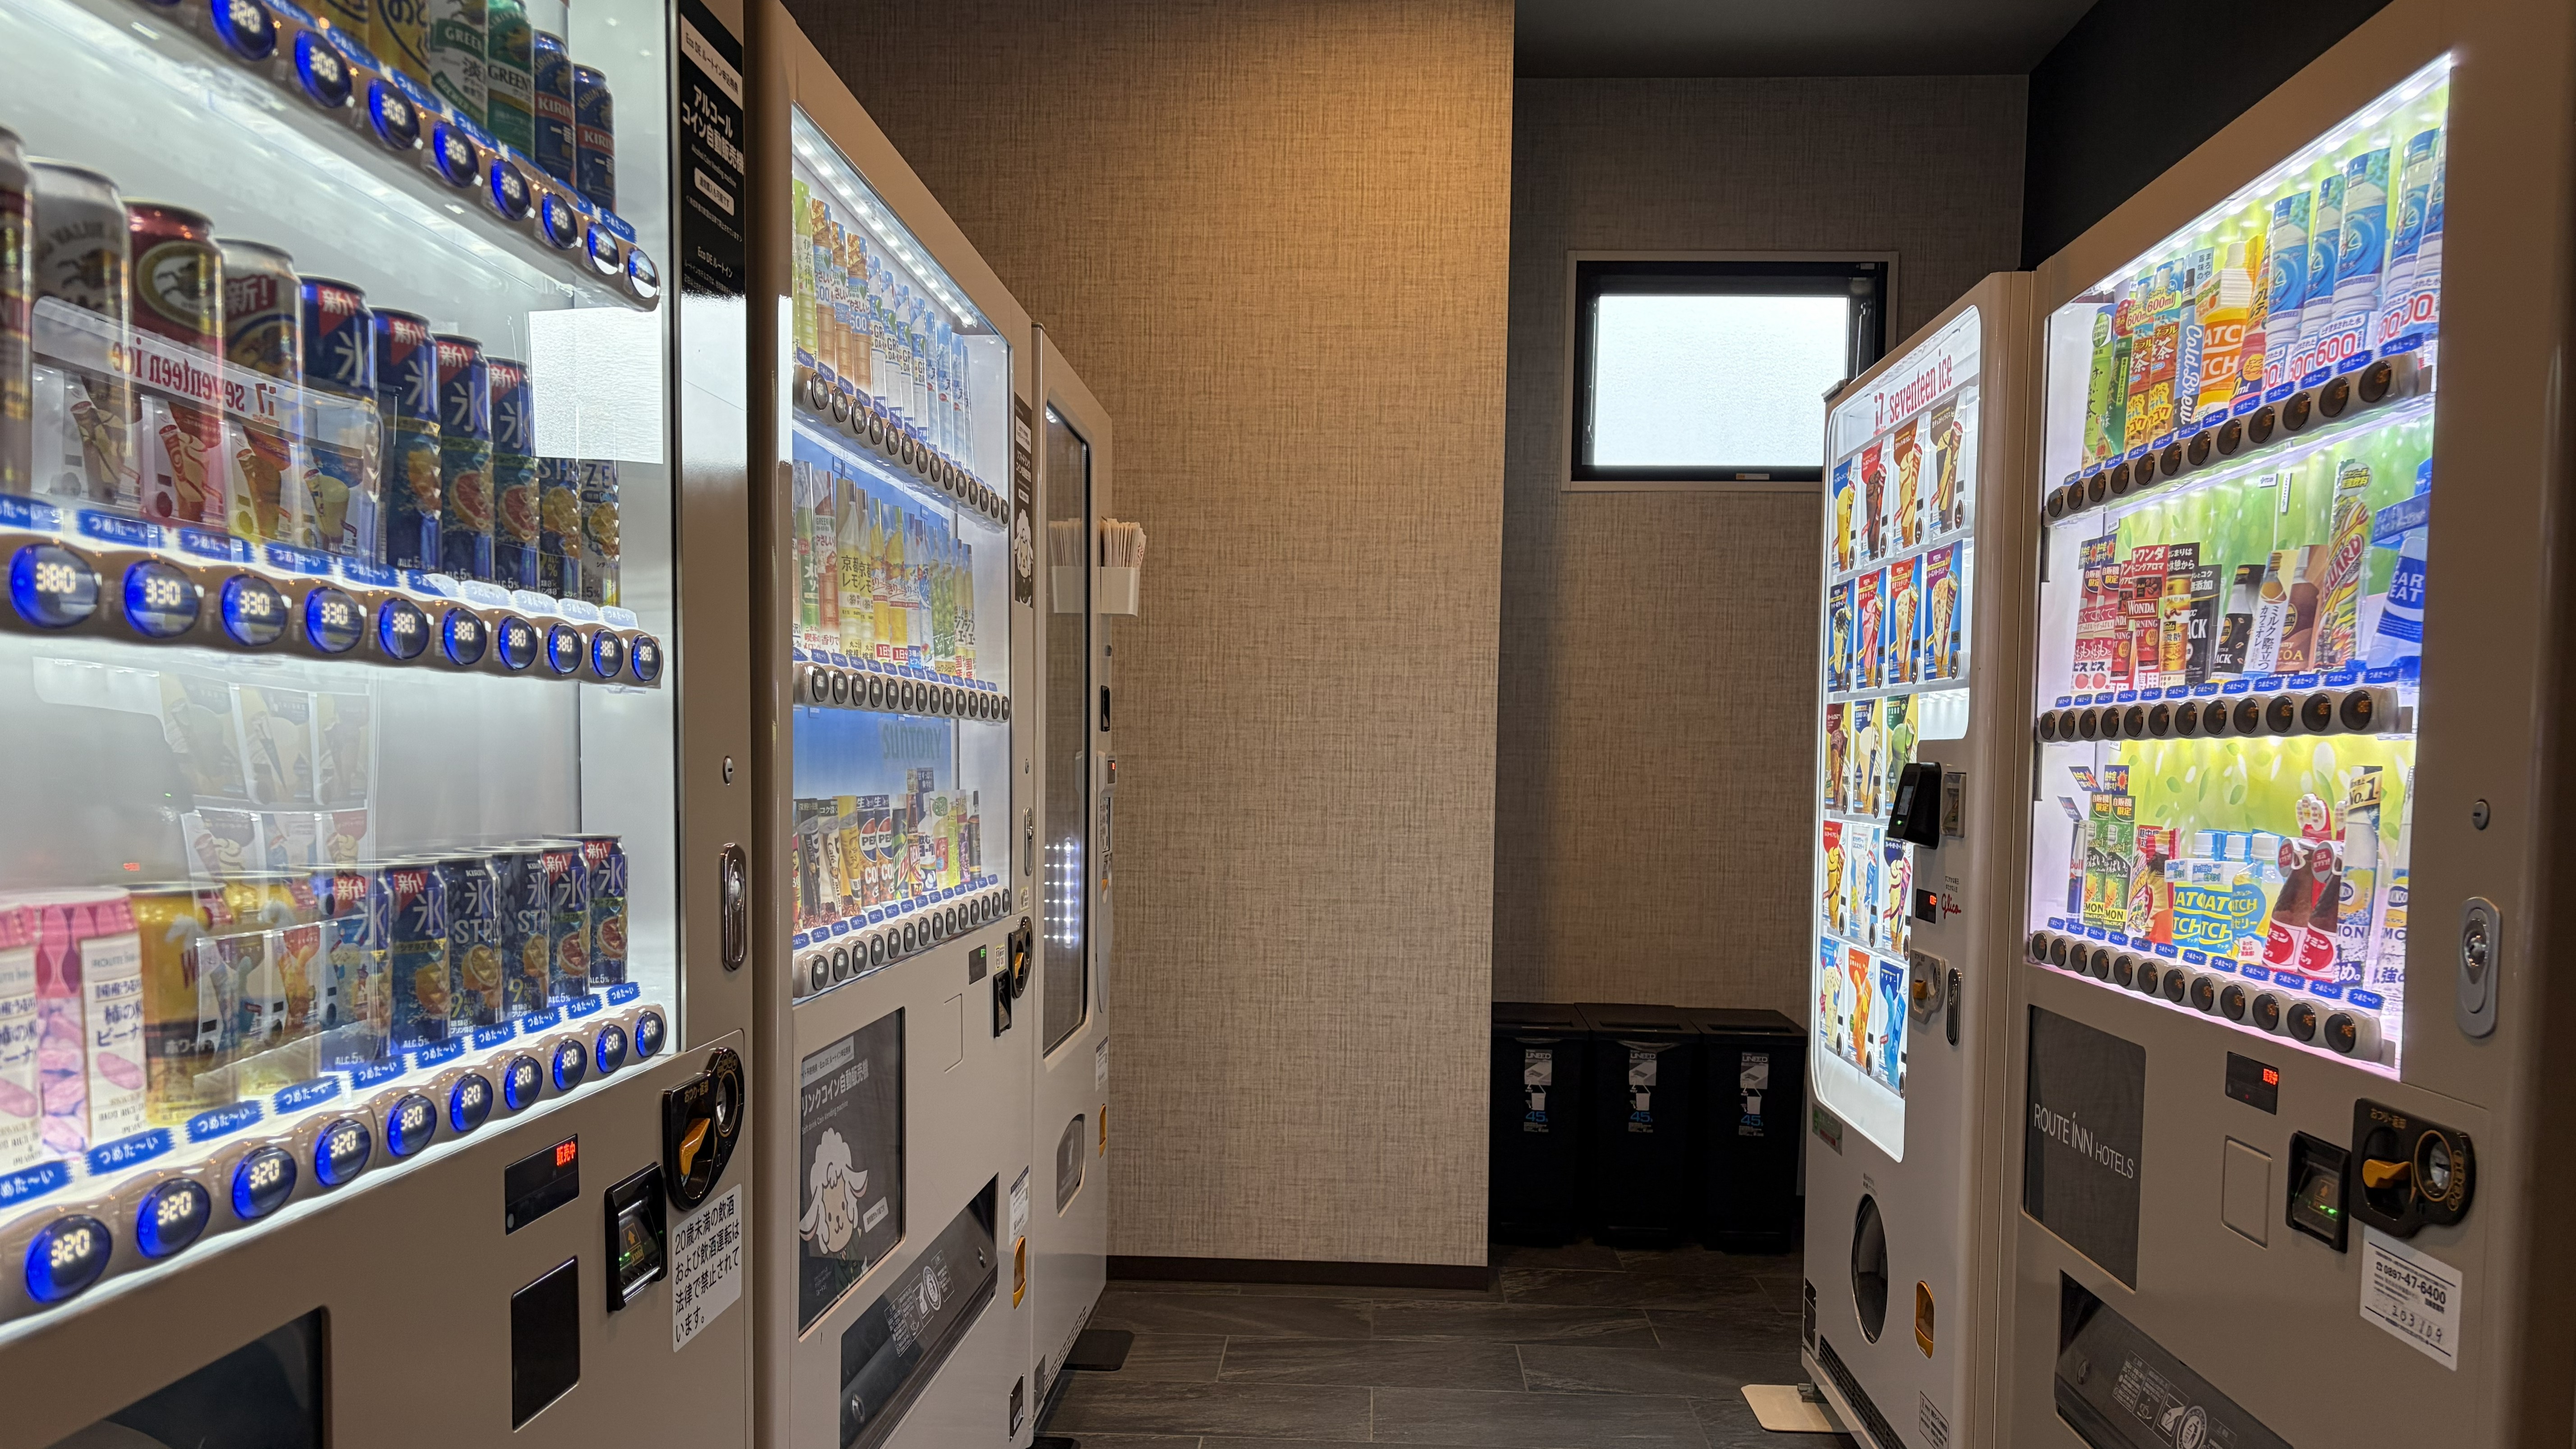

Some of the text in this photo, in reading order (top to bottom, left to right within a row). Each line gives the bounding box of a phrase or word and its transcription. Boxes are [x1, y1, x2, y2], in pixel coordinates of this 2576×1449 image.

[2147, 294, 2174, 313] 600ml
[2315, 333, 2356, 368] 600
[1890, 367, 1937, 424] seventeen
[1939, 348, 1952, 394] ice
[36, 563, 76, 593] 380
[146, 579, 180, 605] 330
[240, 592, 270, 615] 330
[321, 602, 348, 625] 330
[2127, 599, 2156, 616] WONDA
[393, 612, 415, 633] 380
[454, 622, 474, 640] 380
[509, 629, 526, 646] 380
[557, 636, 572, 652] 380
[600, 641, 614, 657] 380
[639, 646, 652, 661] 380
[2117, 807, 2132, 816] 限定
[587, 842, 608, 860] 新!
[1941, 893, 1962, 920] Glico
[644, 1020, 656, 1036] 320
[605, 1034, 618, 1051] 320
[562, 1049, 577, 1068] 320
[515, 1066, 532, 1087] 320
[461, 1085, 481, 1108] 320
[401, 1106, 423, 1131] 320
[330, 1132, 357, 1158] 320
[2034, 1103, 2070, 1145] ROUTE
[2095, 1141, 2135, 1179] HOTELS
[556, 1141, 576, 1166] 販売中
[250, 1159, 280, 1189] 320
[158, 1191, 192, 1225] 320
[675, 1193, 735, 1256] 20歳未満の飲酒
[52, 1229, 89, 1267] 320
[675, 1220, 740, 1285] および飲酒運転は
[675, 1247, 740, 1316] 法律で禁止されて
[675, 1307, 705, 1344] います。
